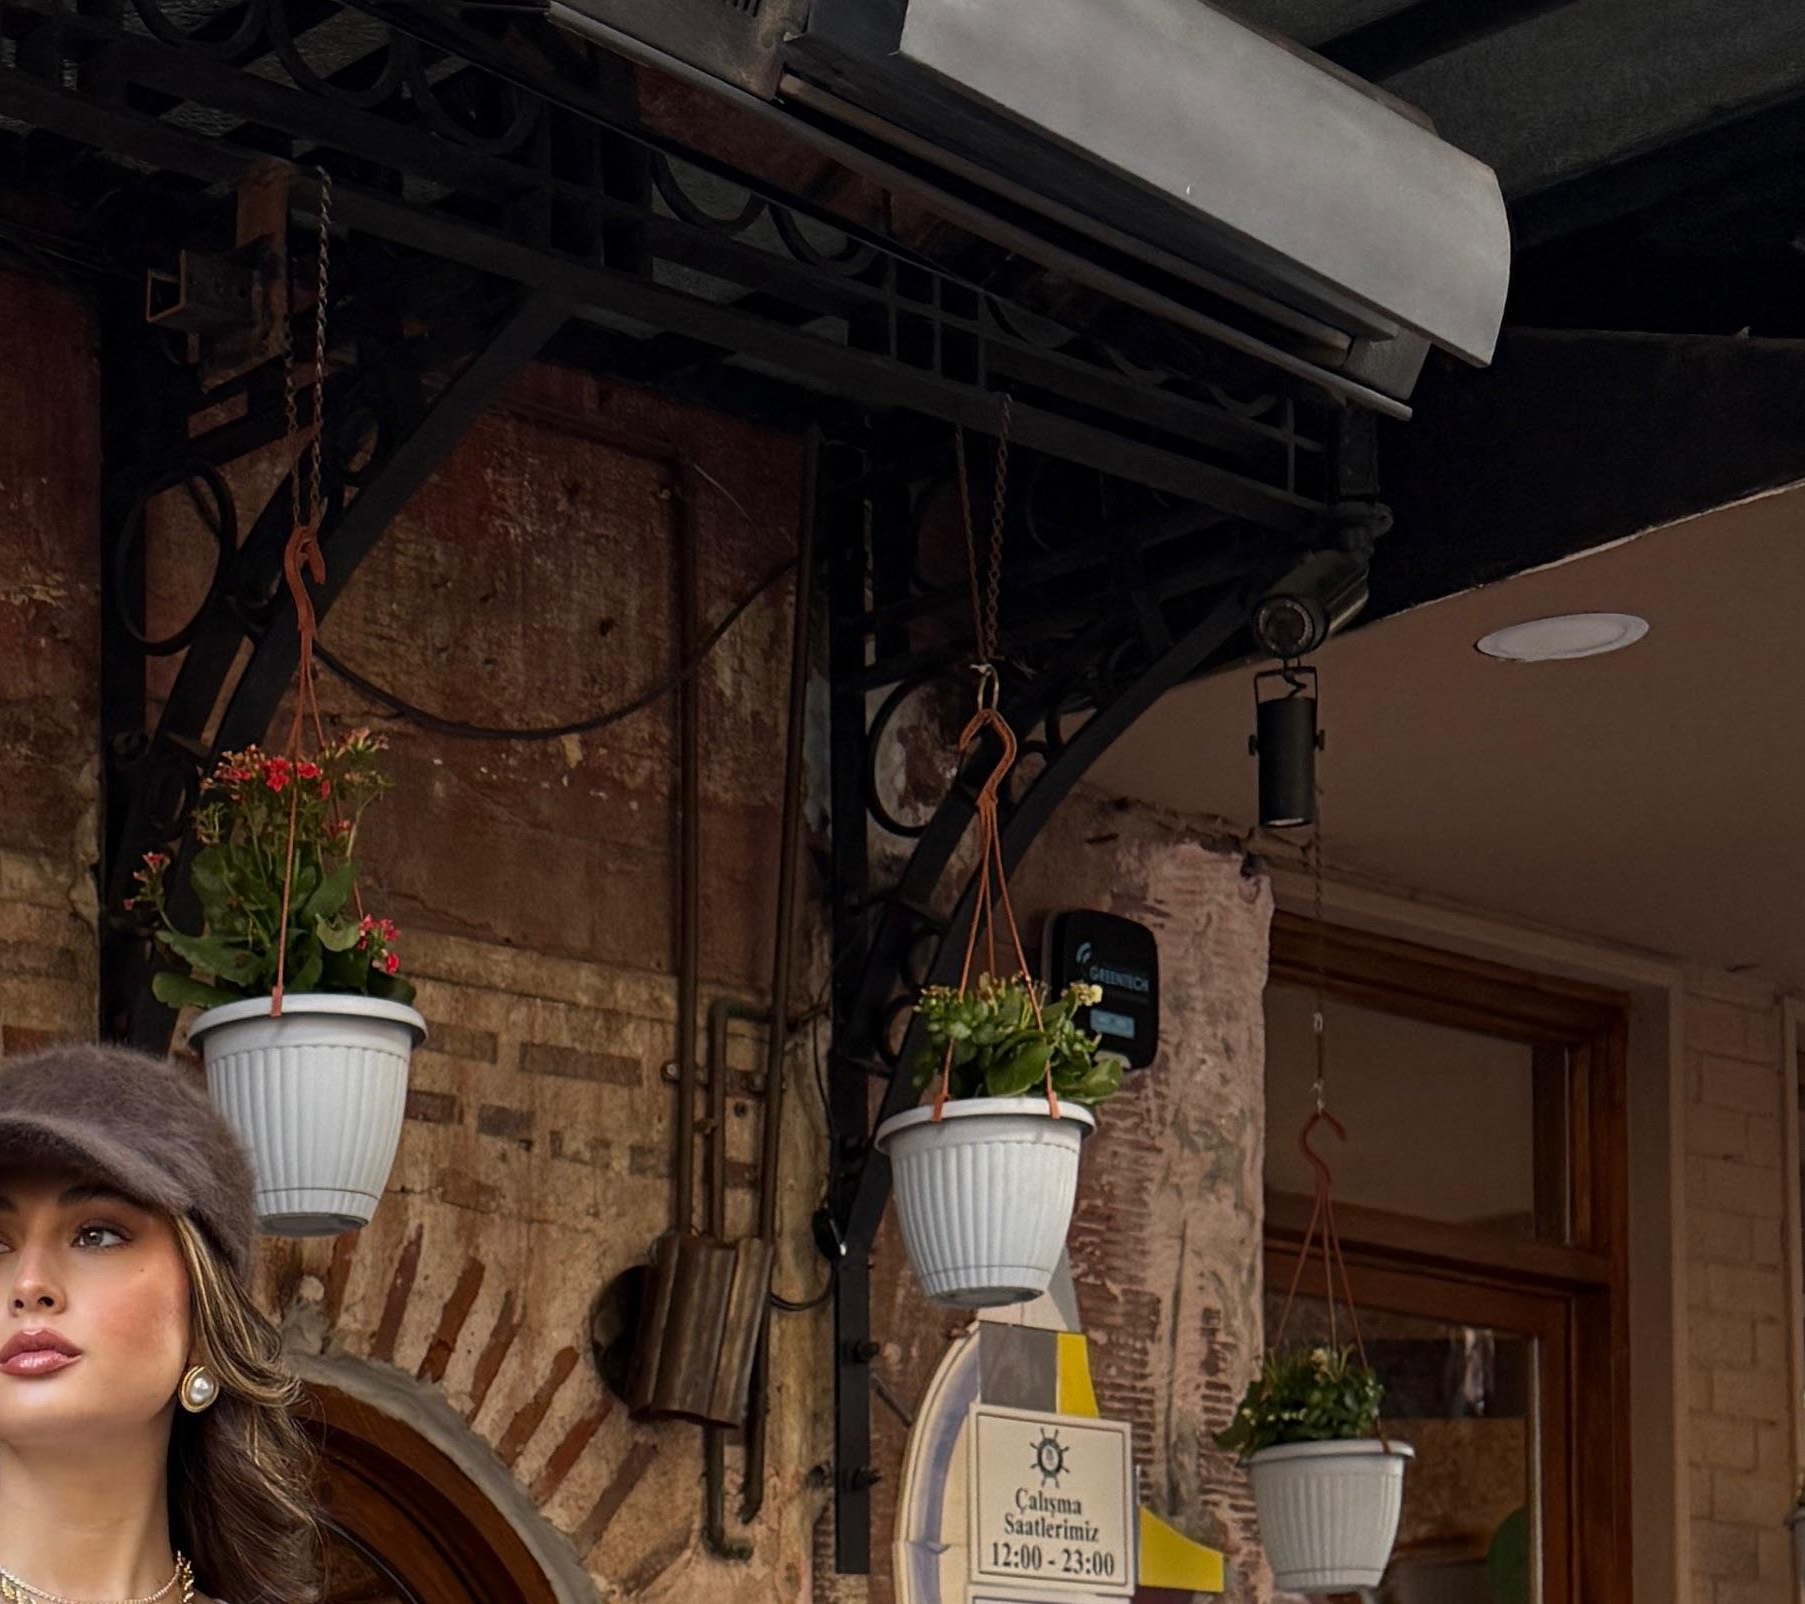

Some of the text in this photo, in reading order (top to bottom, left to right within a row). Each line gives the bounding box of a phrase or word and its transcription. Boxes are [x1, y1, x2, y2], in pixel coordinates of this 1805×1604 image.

[1015, 1487, 1082, 1518] Çalışma
[1004, 1512, 1099, 1543] Saatlerimiz
[992, 1542, 1043, 1571] 12:00
[1062, 1548, 1114, 1577] 23:00
